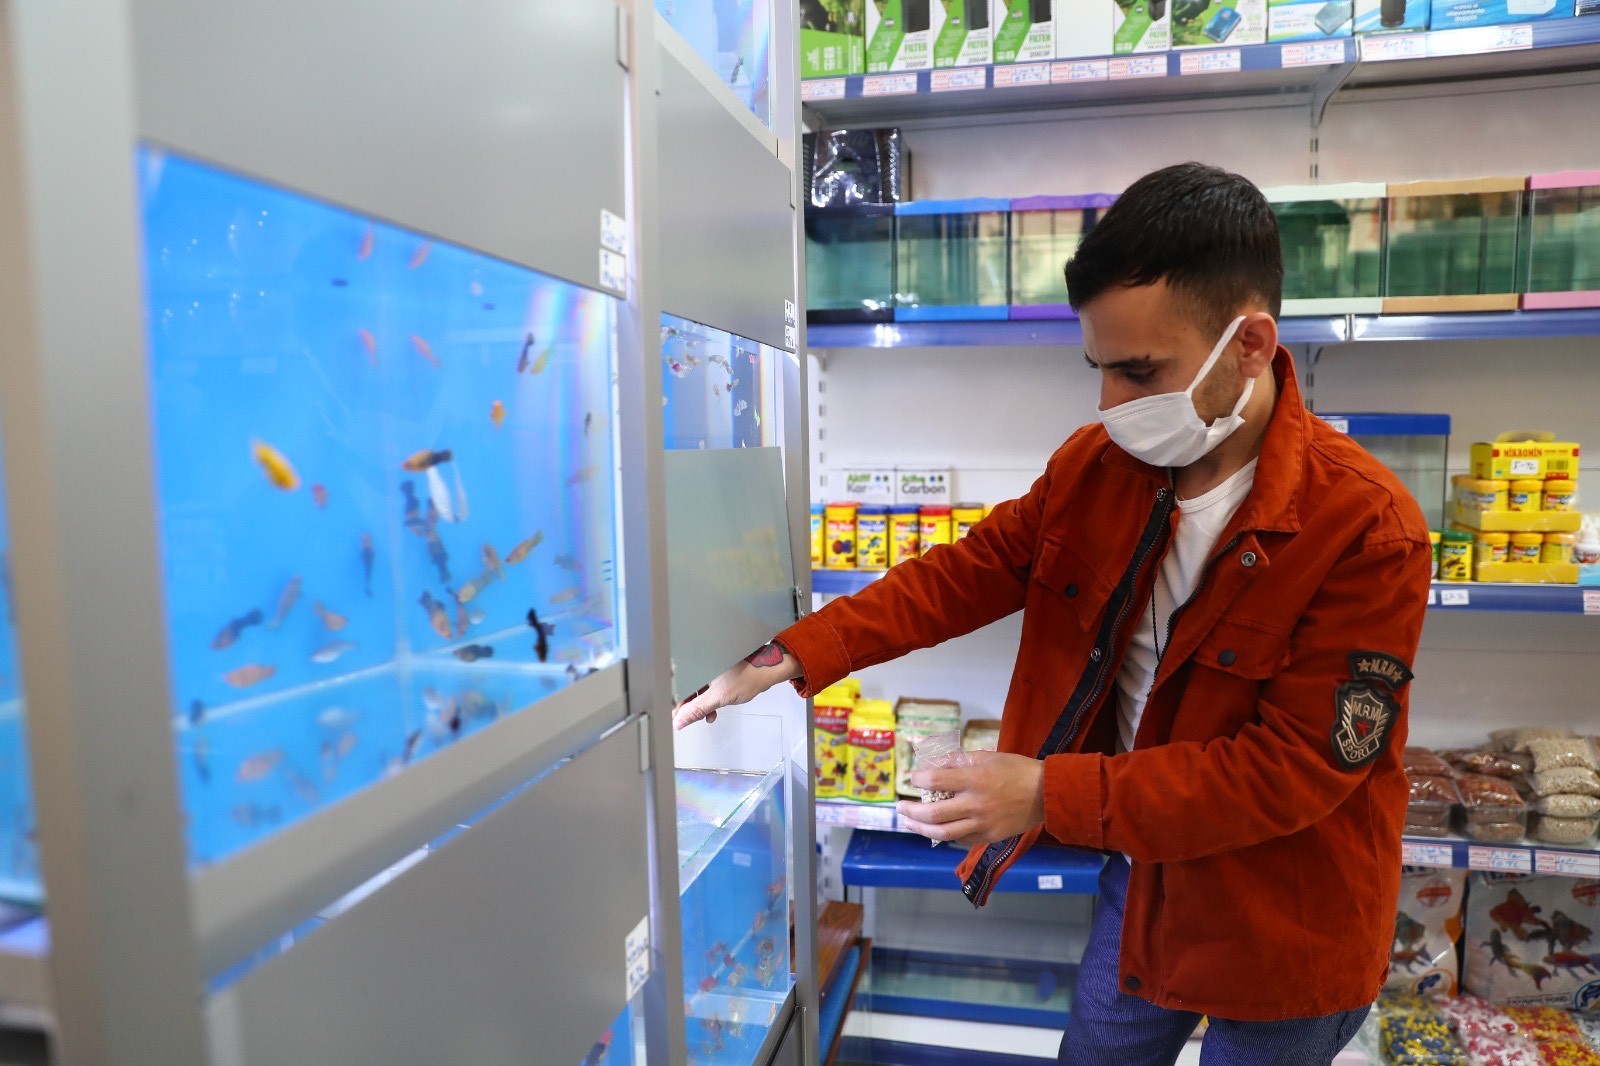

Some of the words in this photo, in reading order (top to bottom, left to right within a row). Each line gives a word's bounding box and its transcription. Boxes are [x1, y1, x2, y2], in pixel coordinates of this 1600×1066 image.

[1029, 34, 1050, 42] FILTER
[904, 43, 928, 52] FILTER
[967, 40, 988, 49] FILTER
[902, 482, 945, 493] Carbon
[1342, 738, 1370, 759] SPORT
